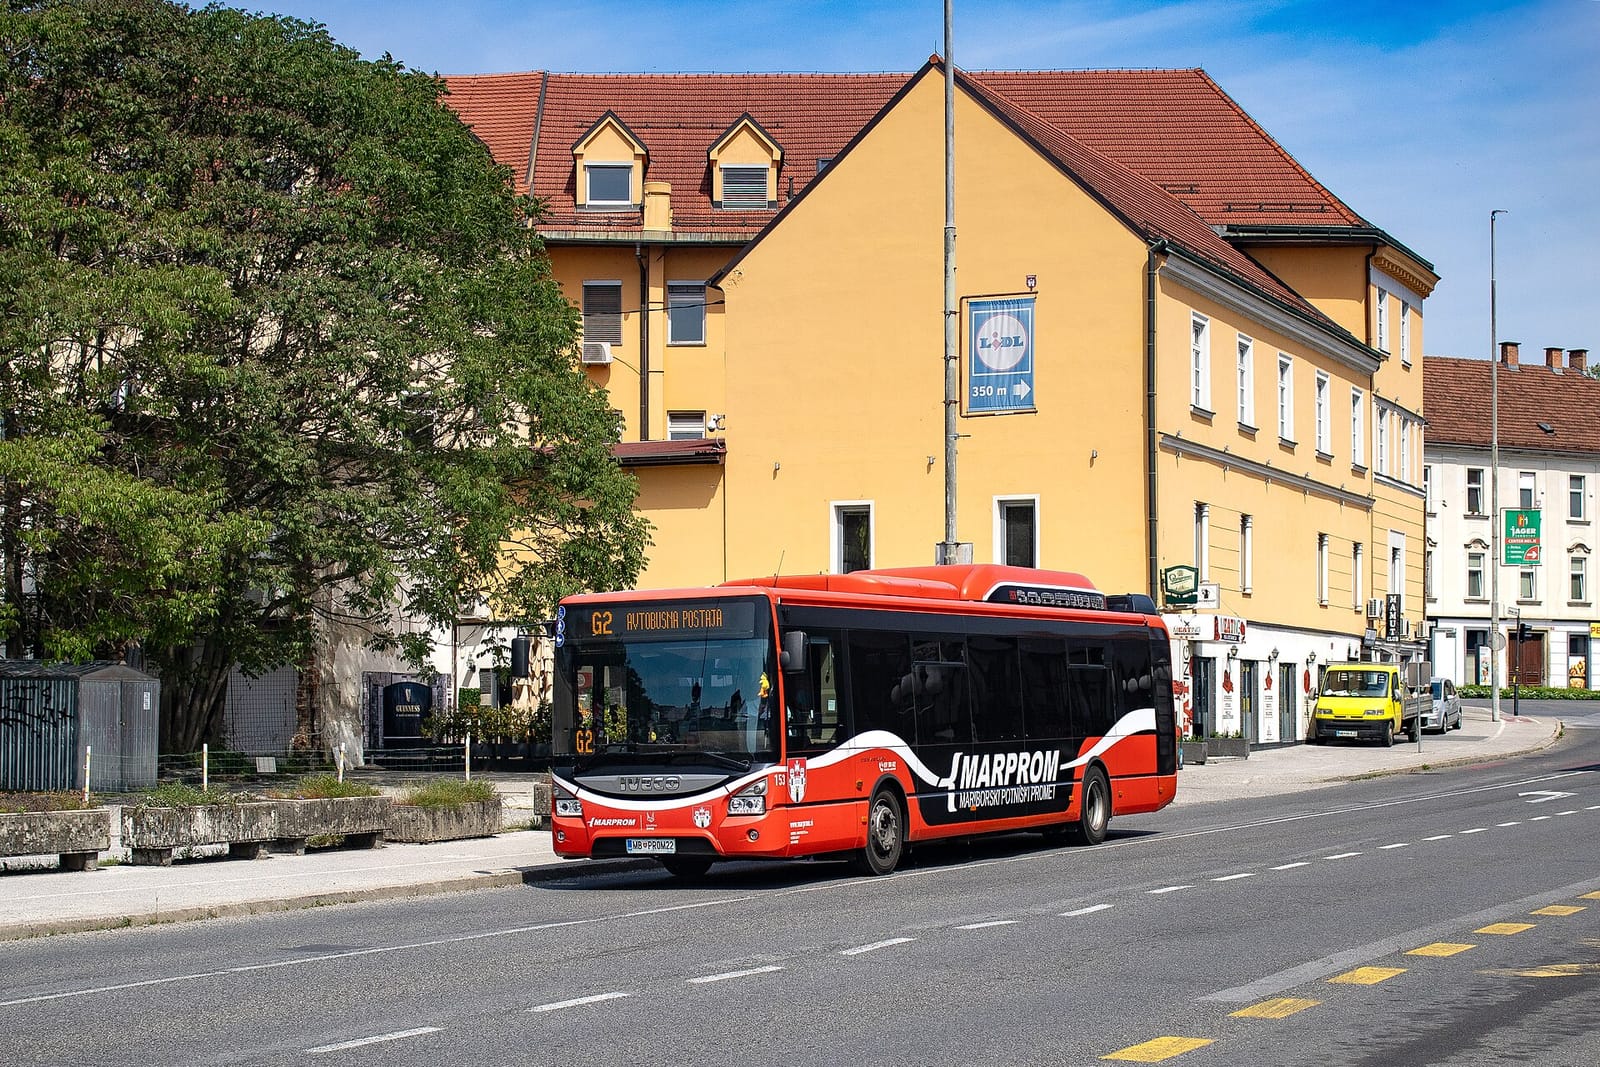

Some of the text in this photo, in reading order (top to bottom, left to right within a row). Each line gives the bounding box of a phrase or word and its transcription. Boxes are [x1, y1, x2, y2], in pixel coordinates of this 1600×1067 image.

[980, 331, 1023, 351] LIDL
[972, 386, 1007, 397] 350 m
[592, 608, 723, 635] G2 AVTOBUSNA POSTAJA
[1389, 595, 1397, 636] MAMUT
[576, 730, 593, 753] G2
[960, 750, 1060, 789] MARPROM
[619, 776, 681, 791] IVECO
[959, 788, 1000, 808] MARIBORSKI
[1031, 784, 1057, 801] PROMET
[594, 818, 636, 827] MARPROM
[632, 841, 642, 850] MB
